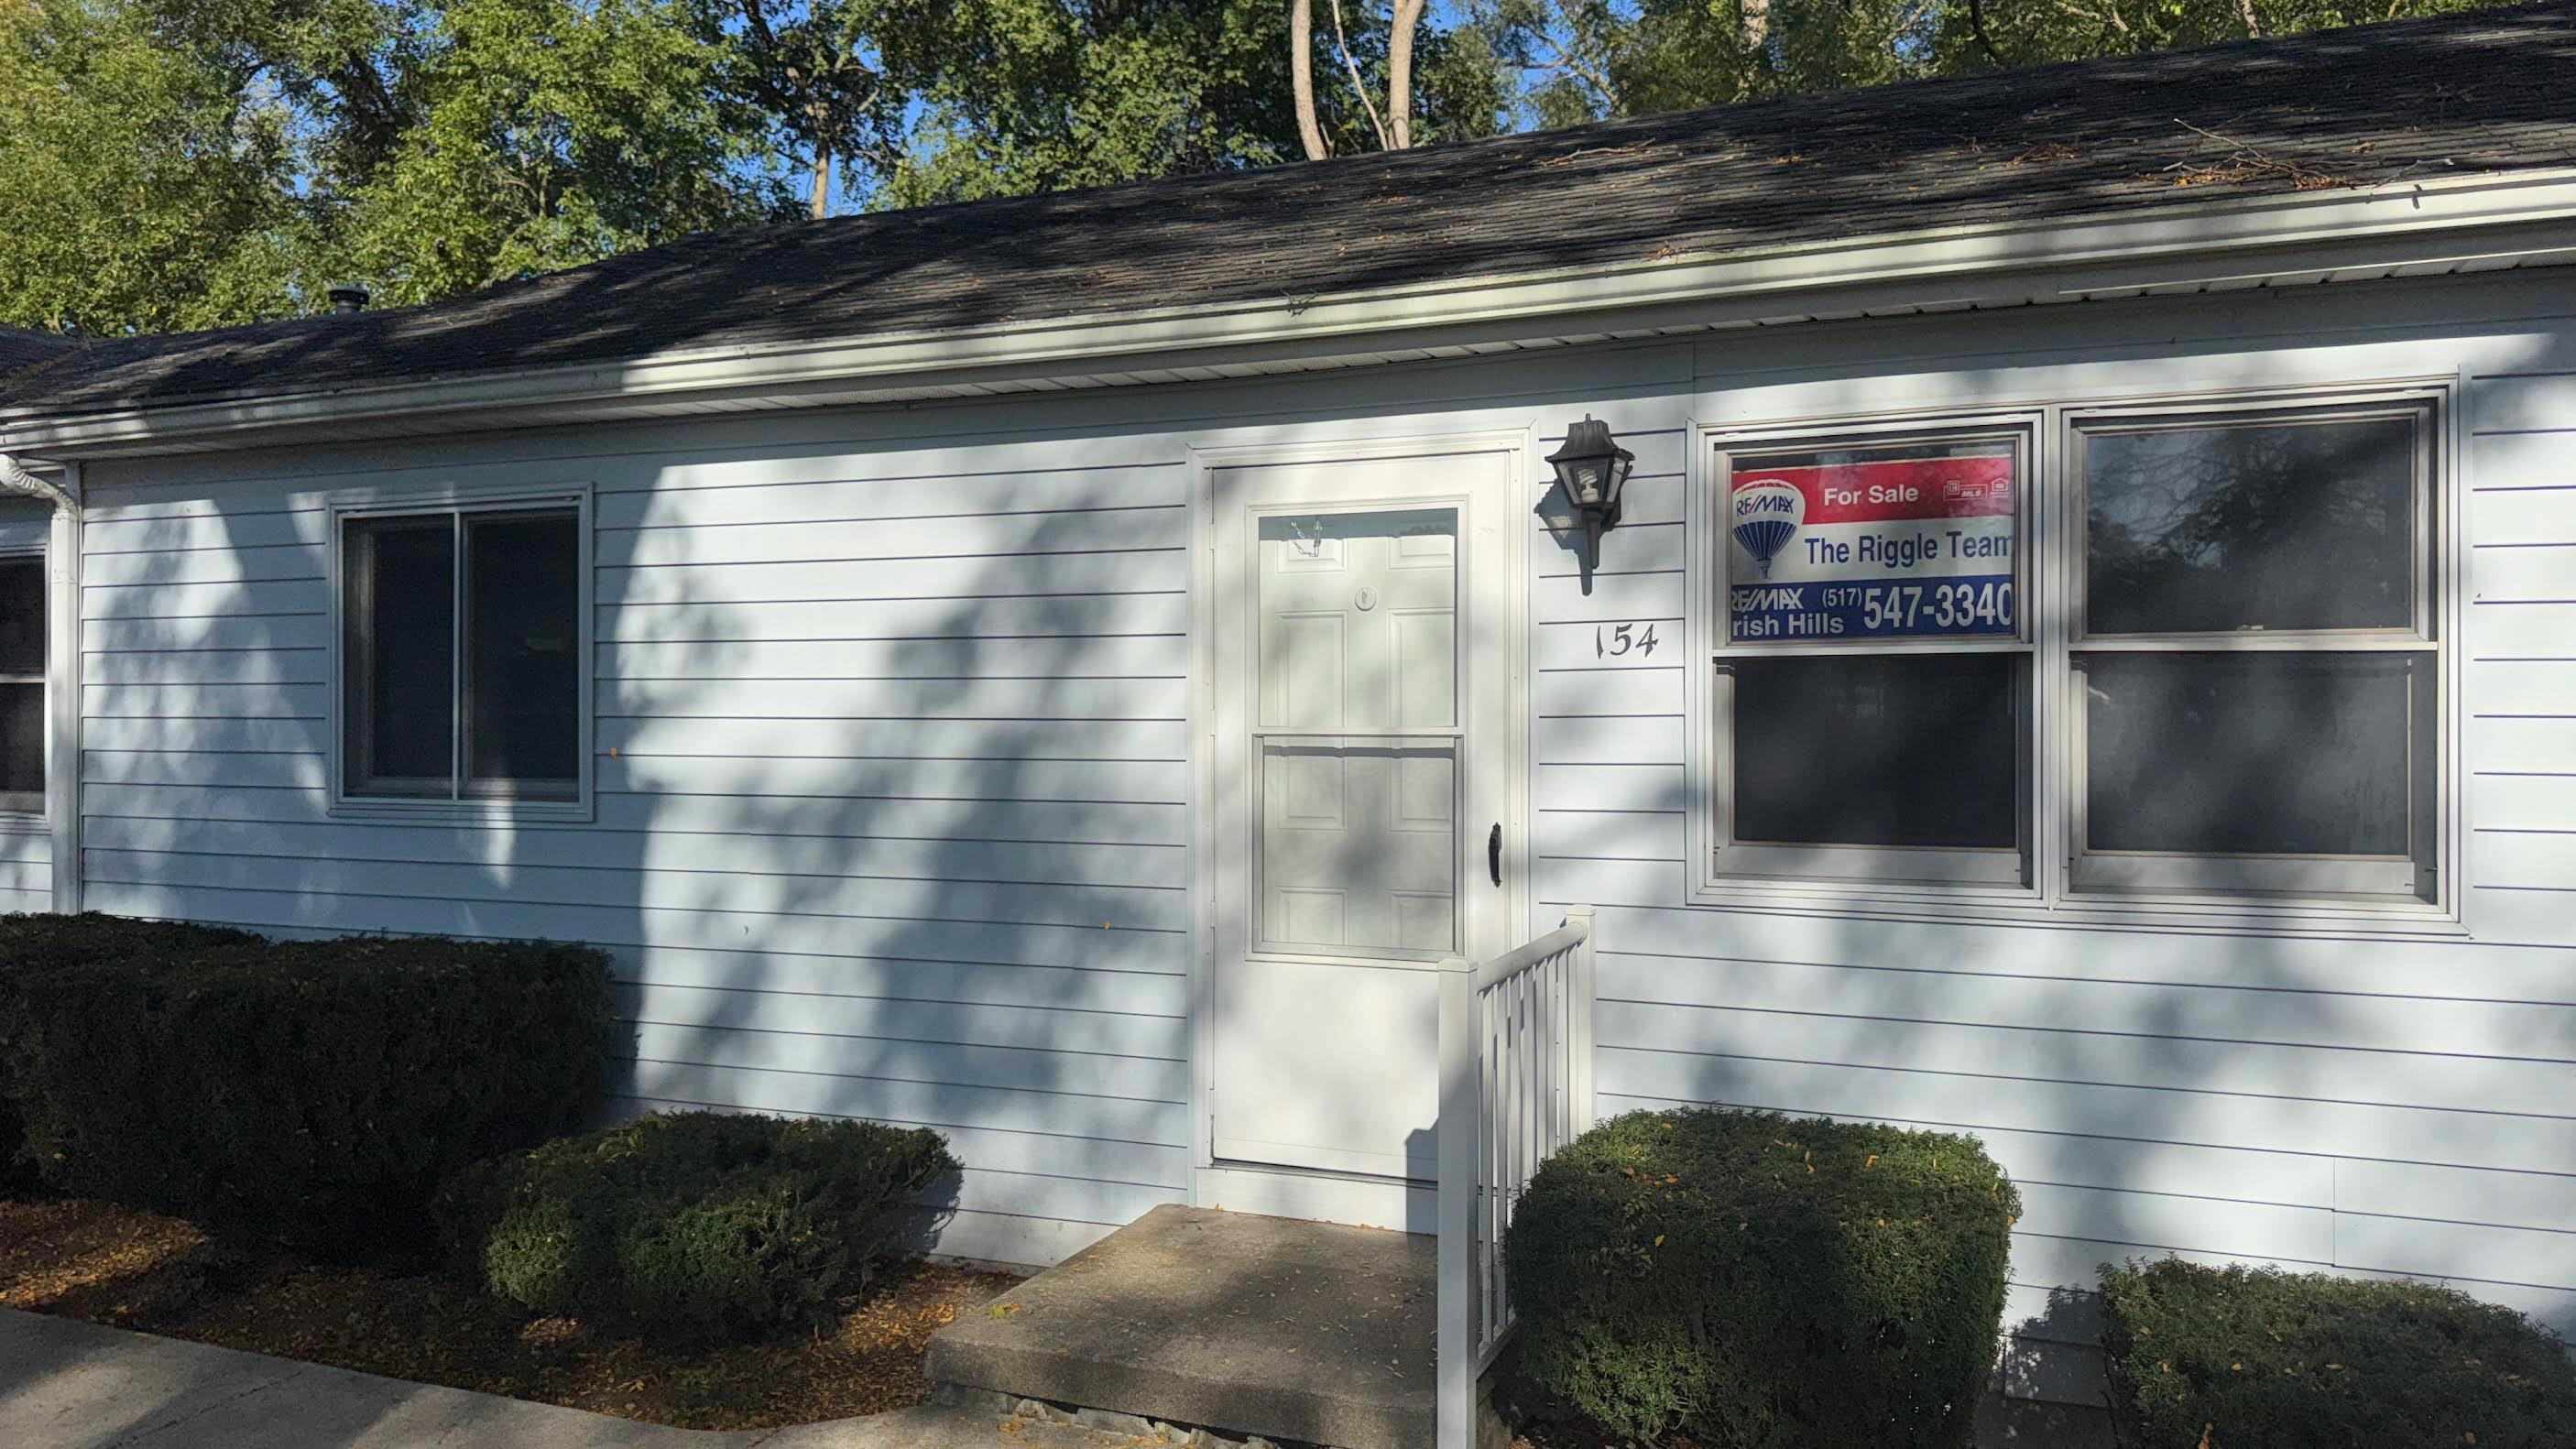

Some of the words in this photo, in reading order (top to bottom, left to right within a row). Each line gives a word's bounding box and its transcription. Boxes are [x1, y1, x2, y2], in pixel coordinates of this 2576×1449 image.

[1823, 487, 1862, 507] For
[1868, 485, 1919, 505] Sale
[1961, 489, 1981, 498] MLS
[1735, 494, 1796, 518] RE/MAX
[1804, 538, 1850, 564] The
[1859, 533, 1938, 568] Riggle
[1946, 531, 2012, 558] Team
[1822, 587, 1862, 608] (517)
[1863, 583, 2012, 630] 547-3340
[1788, 612, 1844, 635] Hills
[1596, 623, 1659, 659] 154
